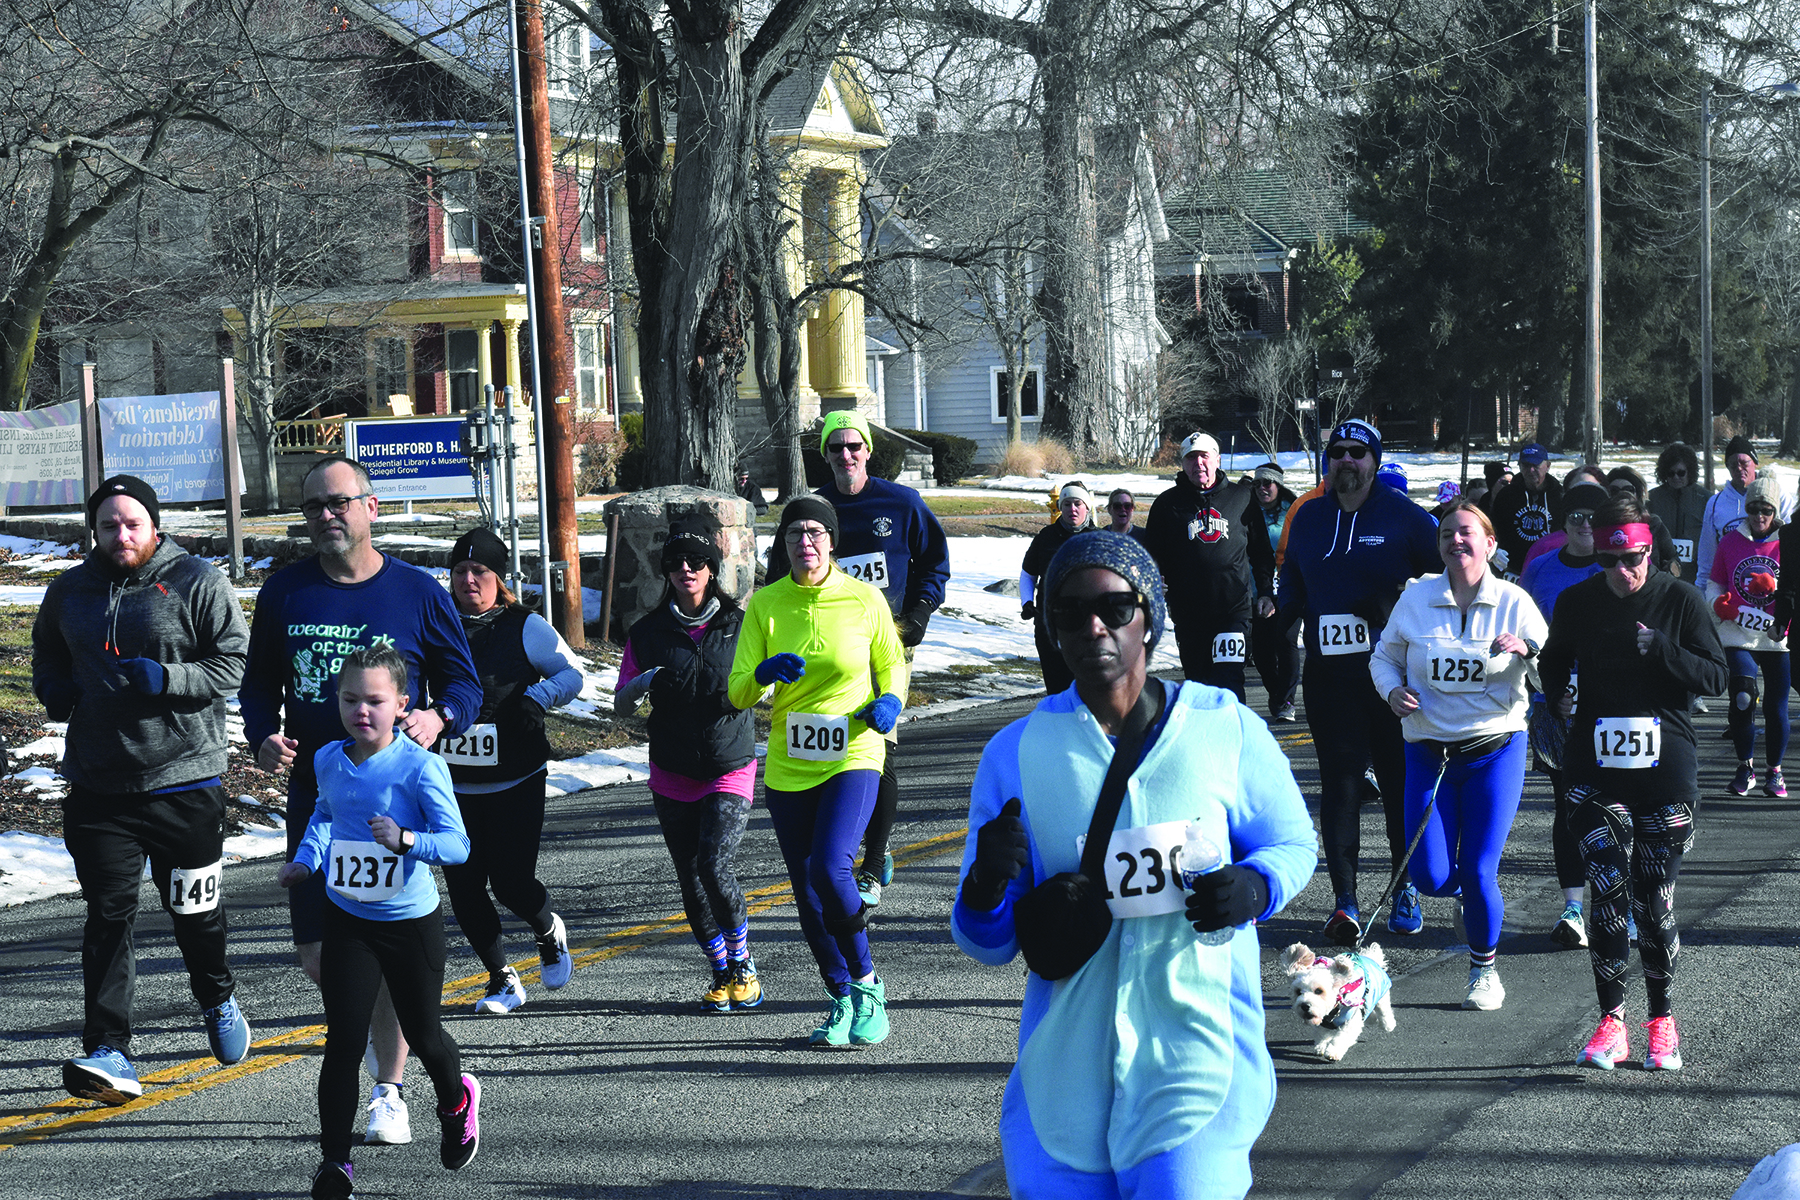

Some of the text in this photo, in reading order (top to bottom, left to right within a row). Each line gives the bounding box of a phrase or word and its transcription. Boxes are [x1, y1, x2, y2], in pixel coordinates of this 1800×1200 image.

[1331, 369, 1343, 378] Rice
[359, 441, 433, 457] RUTHERFORD
[436, 441, 447, 453] B.
[360, 457, 468, 468] Presidential Library & Museum
[369, 466, 419, 477] Spiegel Grove
[398, 484, 427, 492] Entrance
[1737, 611, 1771, 633] 1229
[1321, 623, 1366, 646] 1218
[311, 640, 335, 657] of
[1212, 638, 1245, 658] 1492
[1431, 657, 1484, 682] 1252
[443, 734, 495, 757] 1219
[791, 723, 845, 752] 1209
[1599, 730, 1655, 757] 1251
[333, 855, 399, 889] 1237
[172, 874, 221, 907] 149
